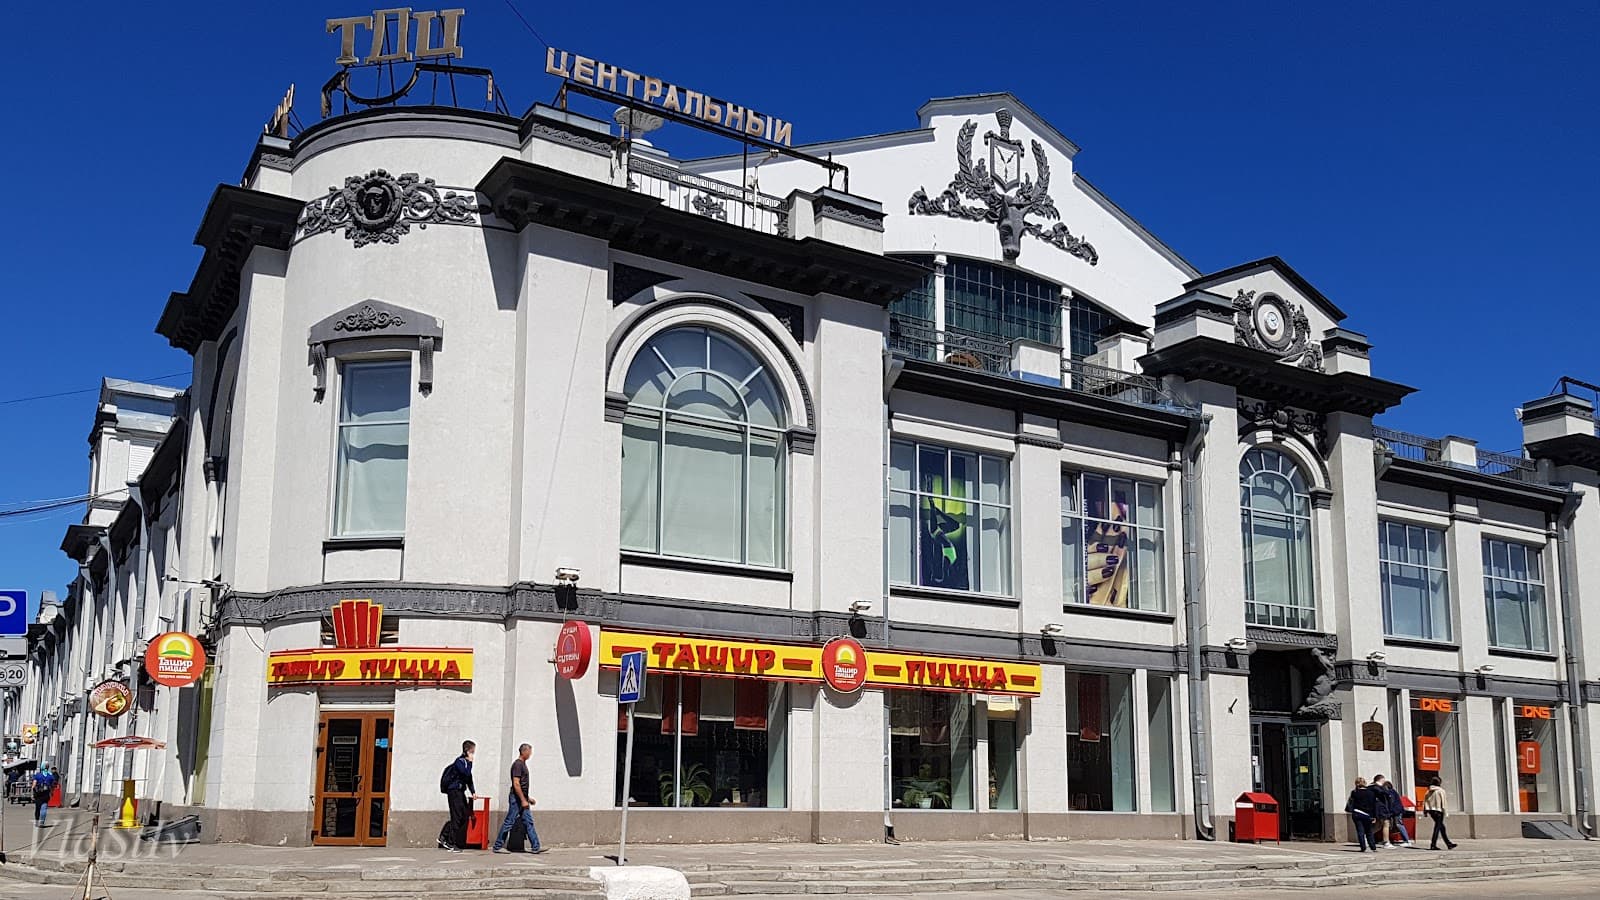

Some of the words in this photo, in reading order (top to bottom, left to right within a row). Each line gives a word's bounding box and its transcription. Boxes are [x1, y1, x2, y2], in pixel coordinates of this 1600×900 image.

[326, 7, 465, 65] ТДЦ
[158, 656, 193, 669] Ташир
[652, 642, 776, 674] ТАШИР
[8, 669, 23, 679] 20
[271, 659, 345, 680] ТАШИР
[360, 659, 461, 680] ПИЦЦА
[905, 660, 1008, 689] ПИЦЦА
[1420, 697, 1453, 712] DNS
[1522, 705, 1552, 719] DNS
